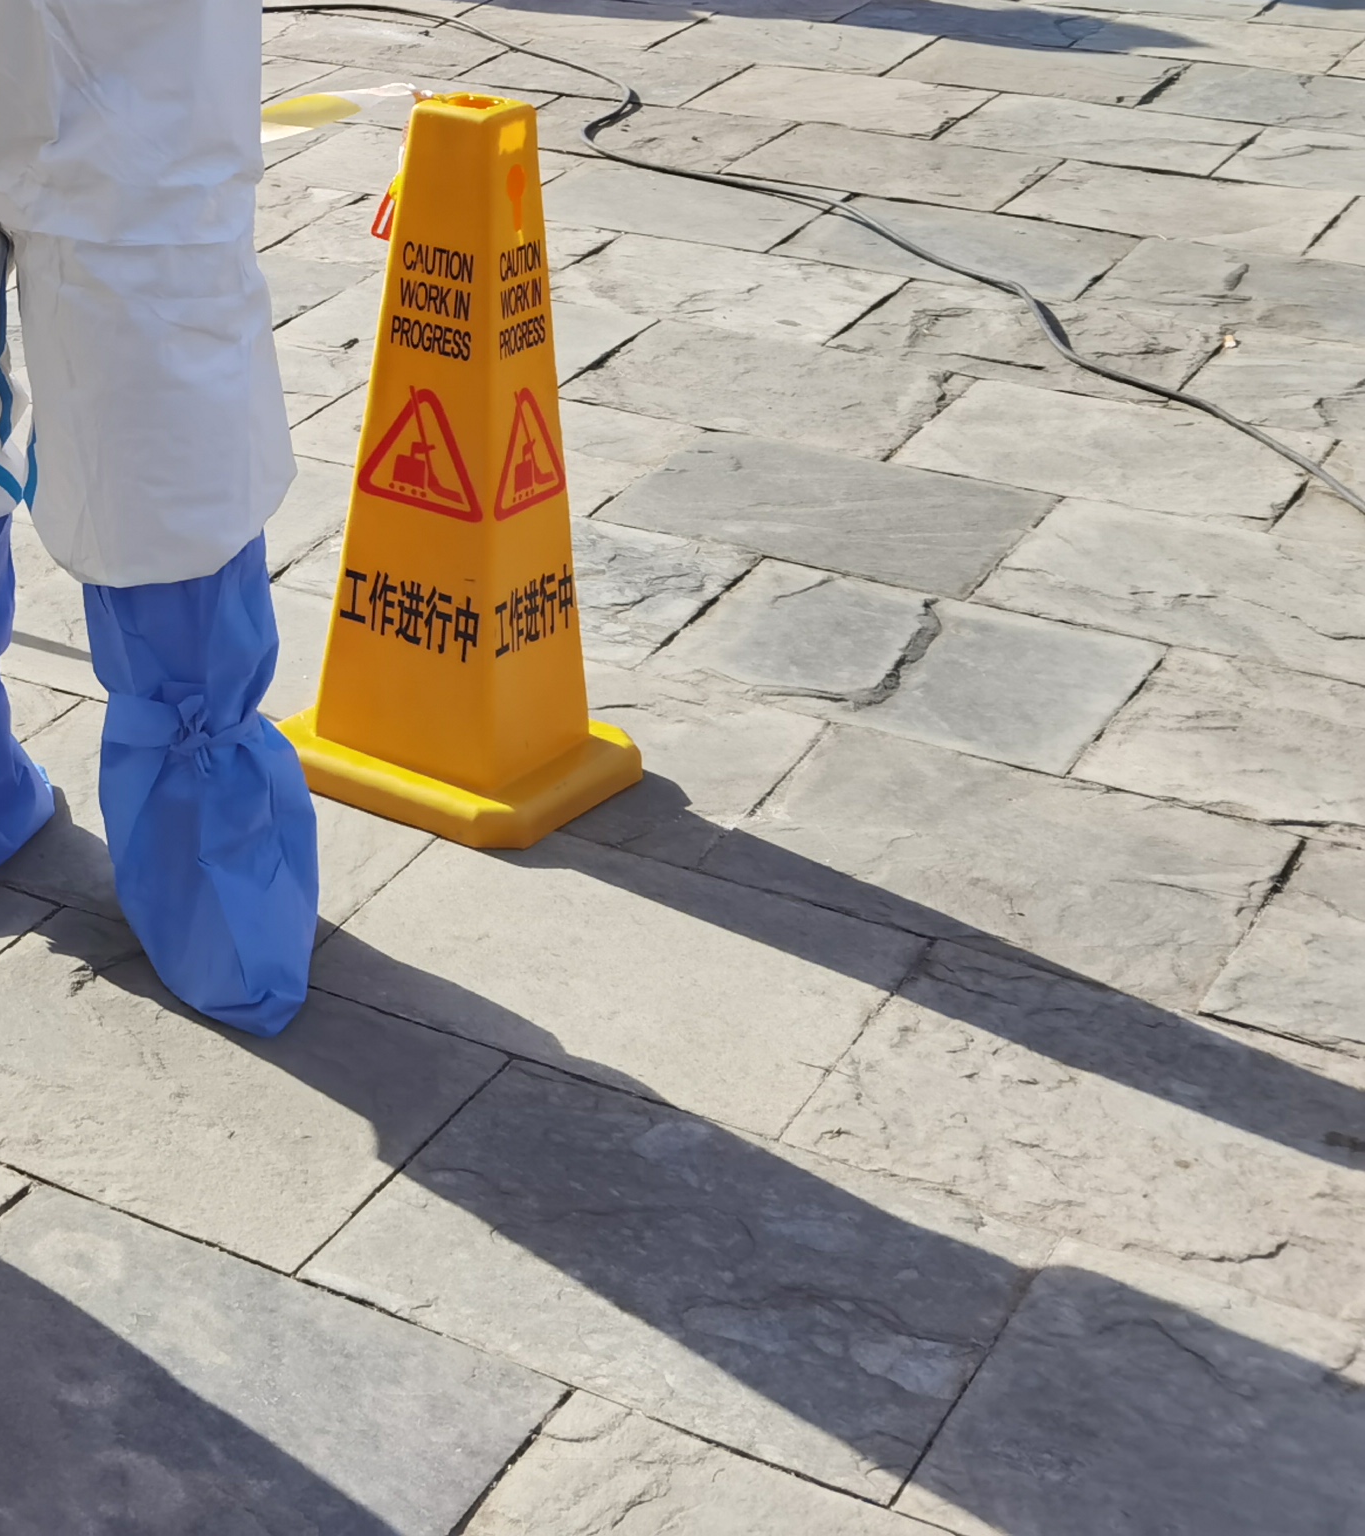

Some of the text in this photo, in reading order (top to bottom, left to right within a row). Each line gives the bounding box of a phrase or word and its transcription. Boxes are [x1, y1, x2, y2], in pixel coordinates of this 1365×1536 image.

[403, 241, 473, 283] CAUTION
[500, 240, 541, 282] CAUTION
[400, 277, 471, 321] WORK IN
[501, 276, 542, 320] WORK IN
[391, 315, 471, 361] PROGRESS
[499, 314, 545, 360] PROGRESS
[340, 568, 480, 663] 工作进行中
[495, 563, 574, 658] 工作进行中
